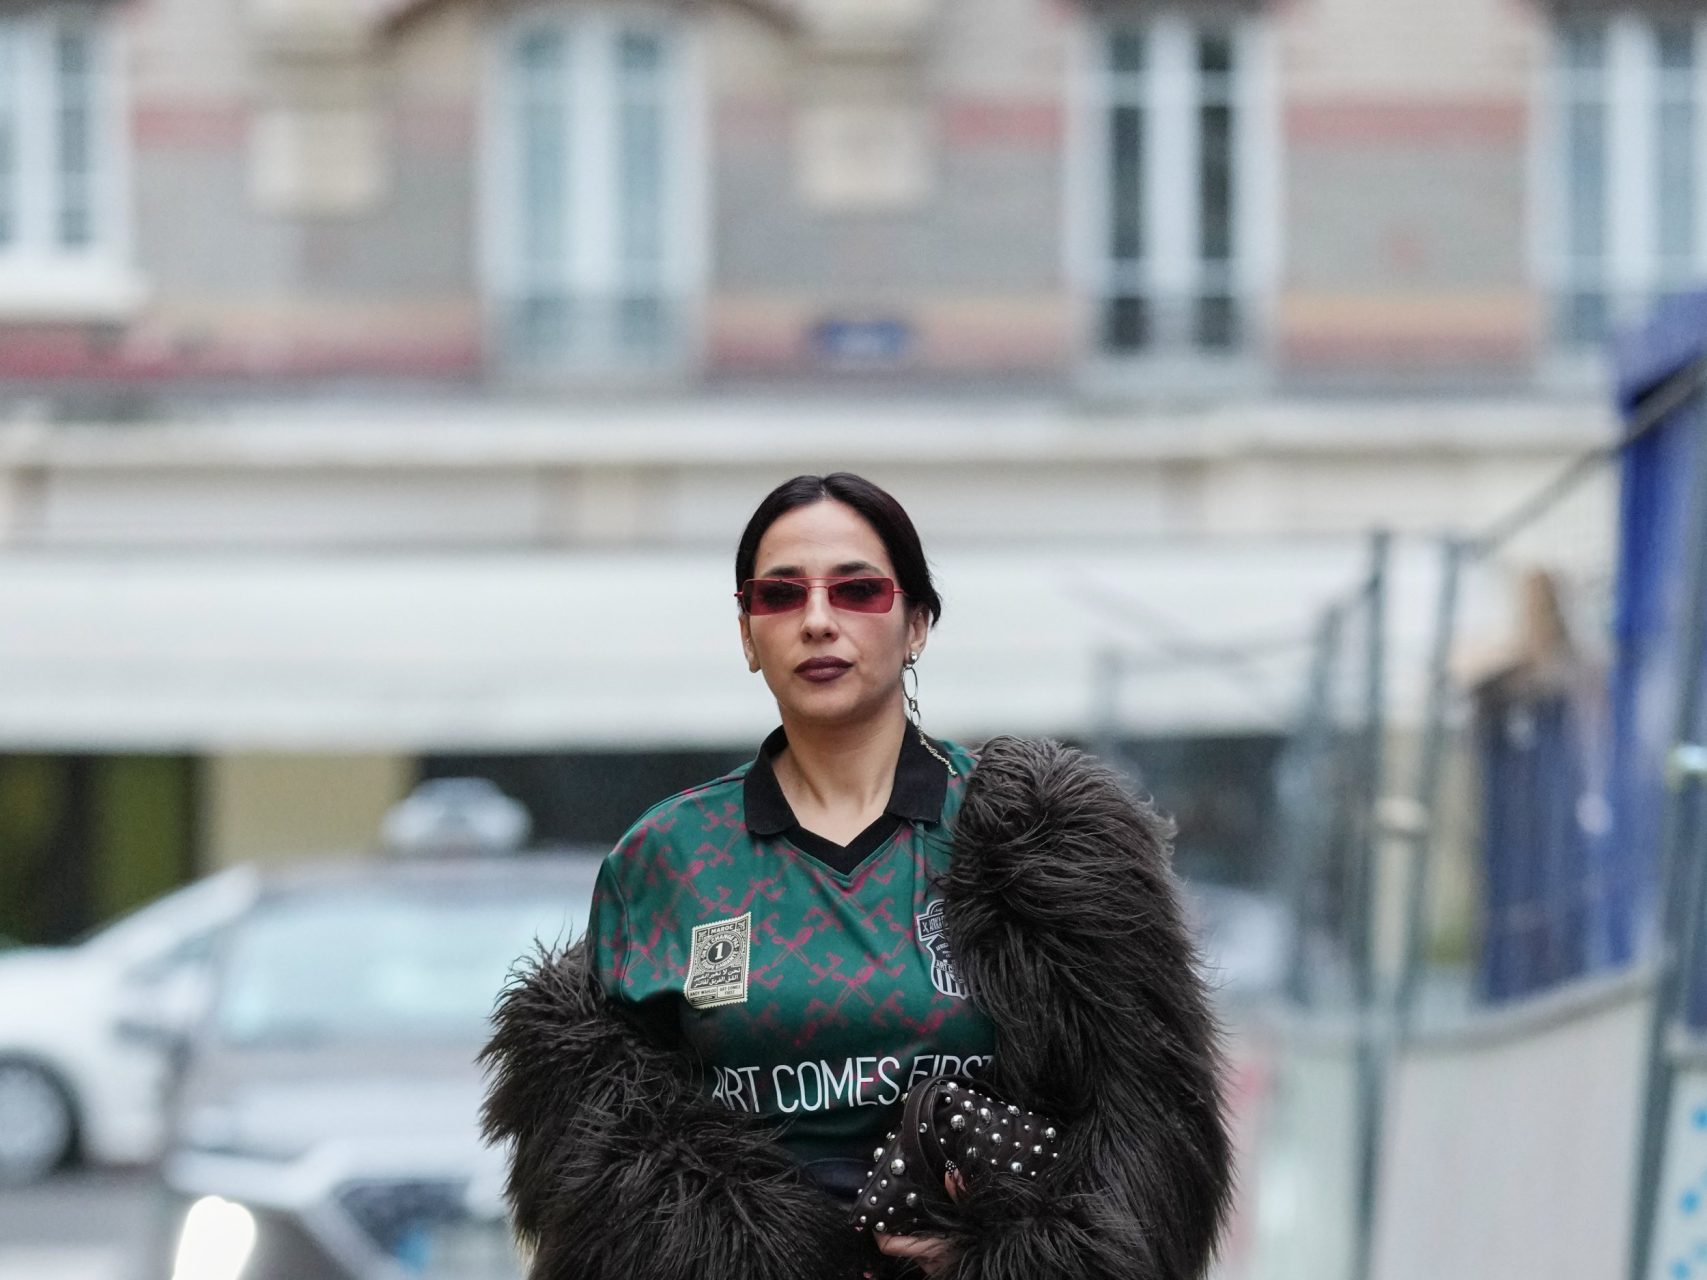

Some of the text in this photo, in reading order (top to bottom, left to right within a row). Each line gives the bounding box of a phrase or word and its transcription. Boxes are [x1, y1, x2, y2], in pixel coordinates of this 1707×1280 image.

[711, 924, 734, 933] MAROC
[715, 942, 723, 960] 1
[712, 1066, 760, 1112] ART
[773, 1056, 900, 1113] COMES
